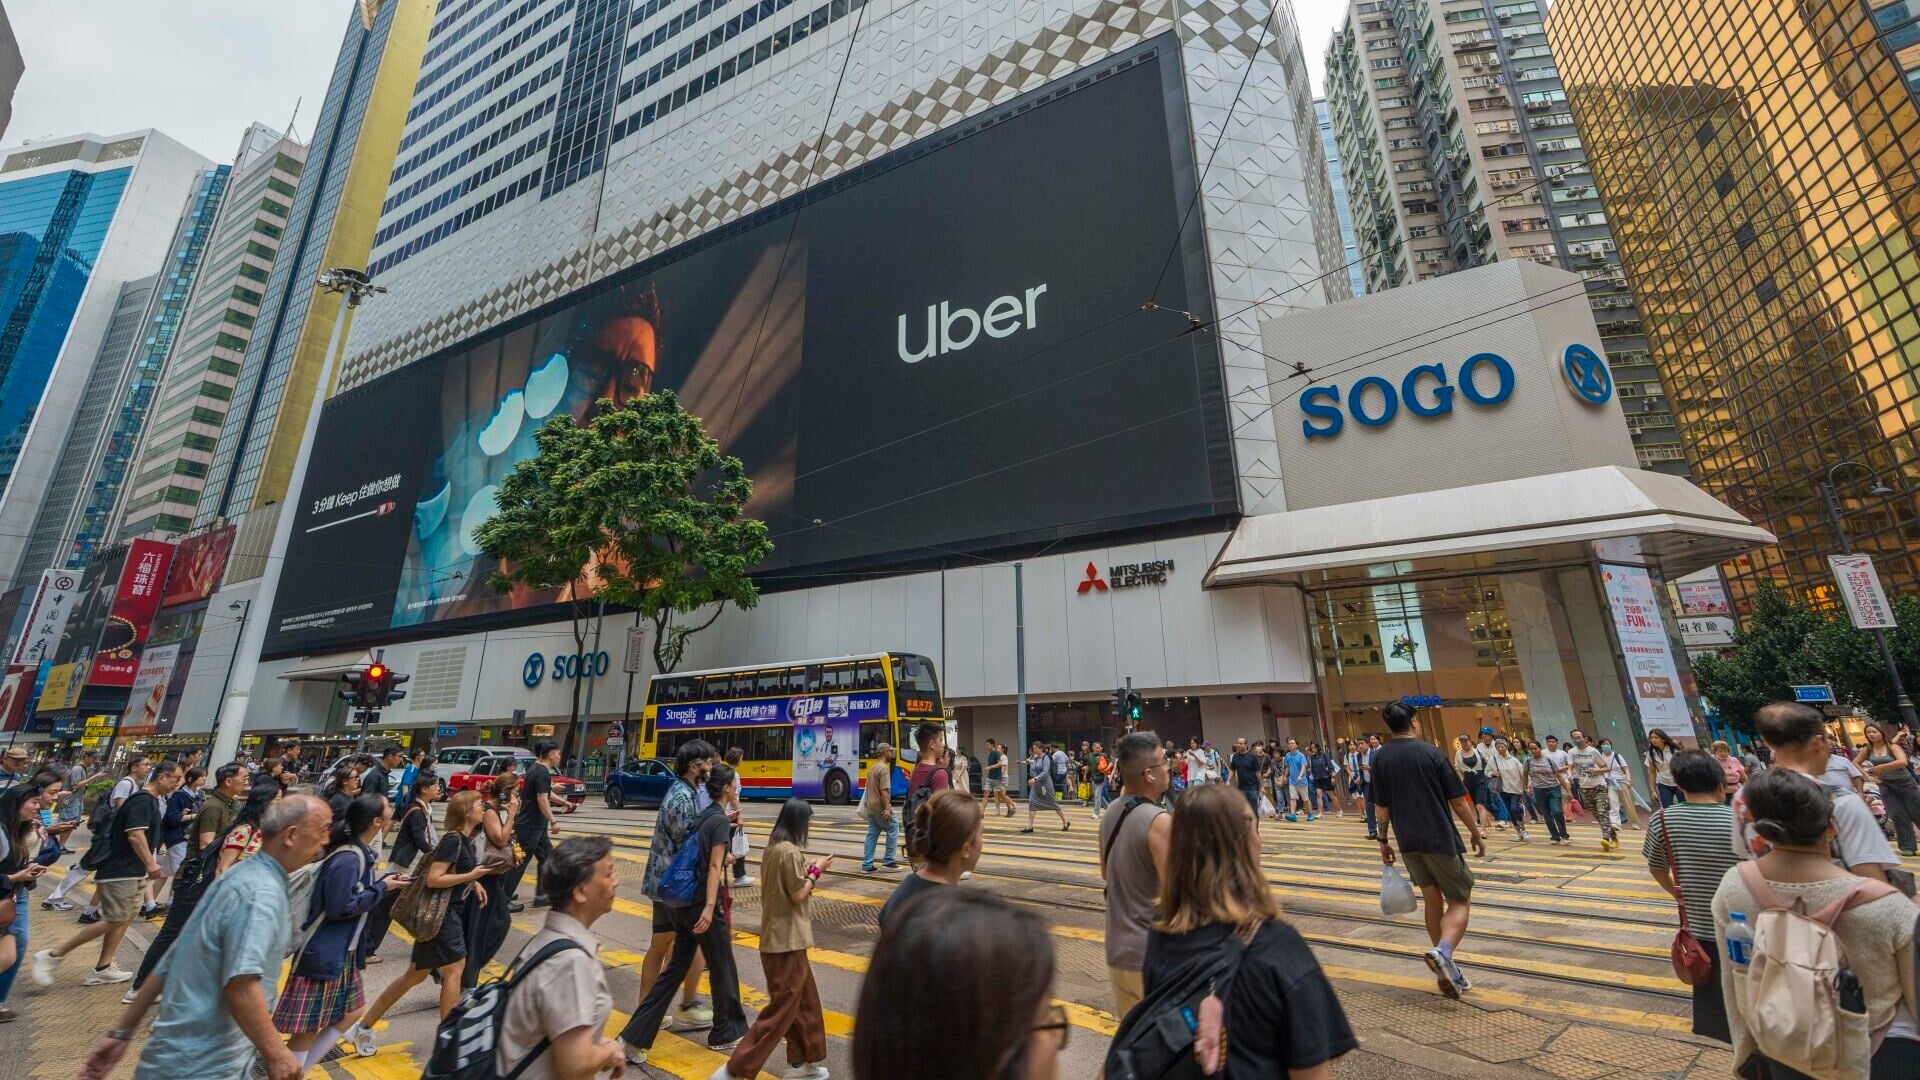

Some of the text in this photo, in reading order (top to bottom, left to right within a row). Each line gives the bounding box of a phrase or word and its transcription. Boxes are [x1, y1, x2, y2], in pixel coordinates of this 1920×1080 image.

[898, 283, 1047, 363] Uber
[1299, 352, 1515, 440] SOGO
[335, 491, 358, 507] Keep
[1109, 559, 1175, 578] MITSUBISHI
[1110, 572, 1167, 589] ELECTRIC
[1851, 572, 1878, 626] HONG KONG
[1625, 614, 1646, 628] FUN
[551, 650, 609, 681] SOGO
[1401, 694, 1441, 706] SOGO
[665, 707, 697, 722] Strepsils
